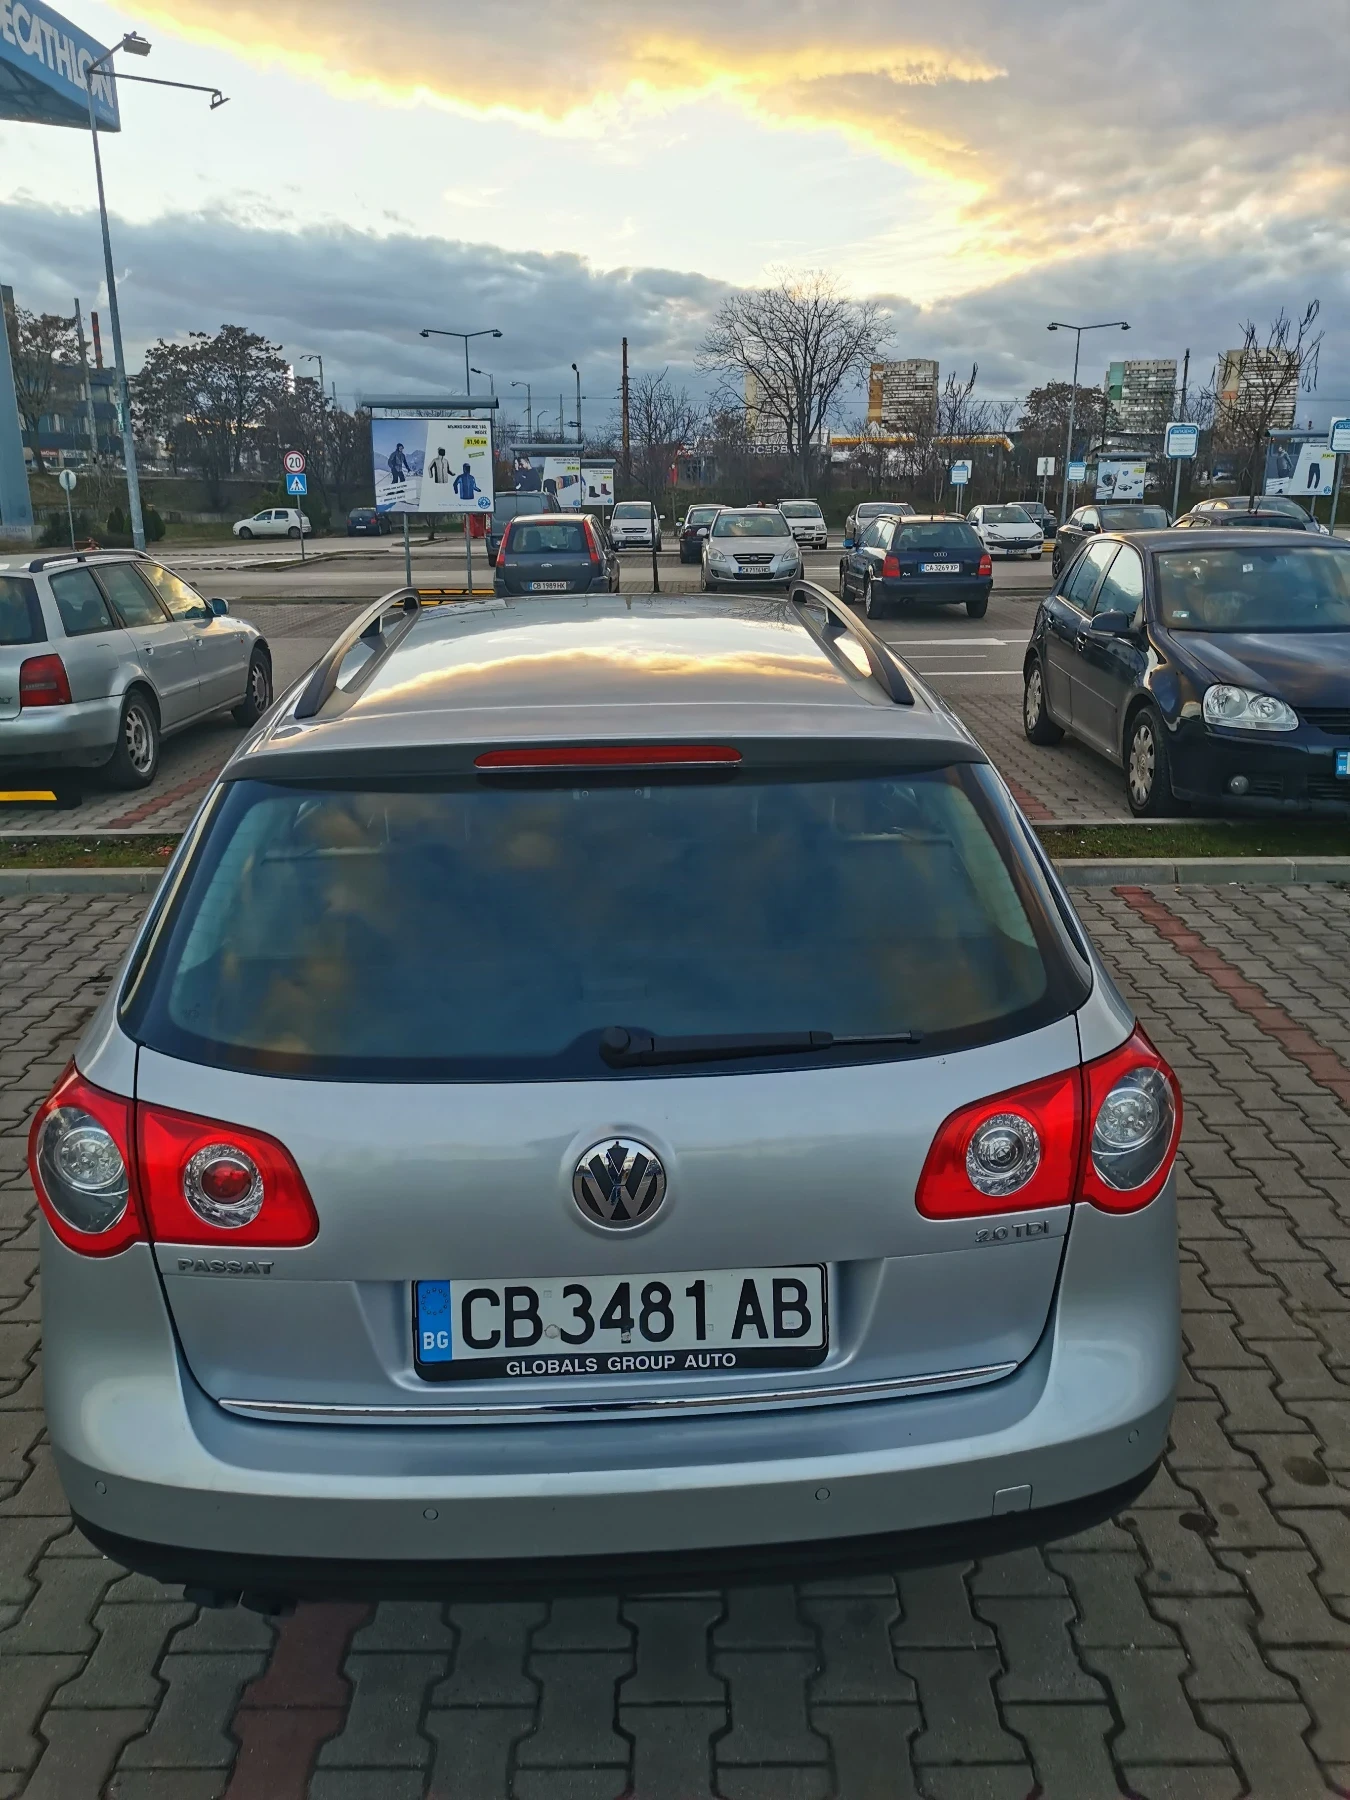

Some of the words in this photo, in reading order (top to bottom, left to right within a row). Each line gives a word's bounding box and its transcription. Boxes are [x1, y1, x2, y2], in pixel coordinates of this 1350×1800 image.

[0, 0, 114, 108] ECATHLON
[288, 457, 302, 469] 20
[925, 564, 934, 572] CA
[934, 564, 949, 572] 3269
[533, 582, 542, 590] CB
[975, 1226, 1009, 1243] 2.0
[1012, 1220, 1049, 1239] TDI
[177, 1257, 275, 1275] PASSAT
[460, 1286, 544, 1350] CB
[559, 1279, 707, 1346] 3481
[730, 1278, 812, 1340] AB
[423, 1330, 449, 1350] BG
[506, 1357, 598, 1376] GLOBALS
[607, 1354, 676, 1372] GROUP
[684, 1352, 737, 1369] AUTO
